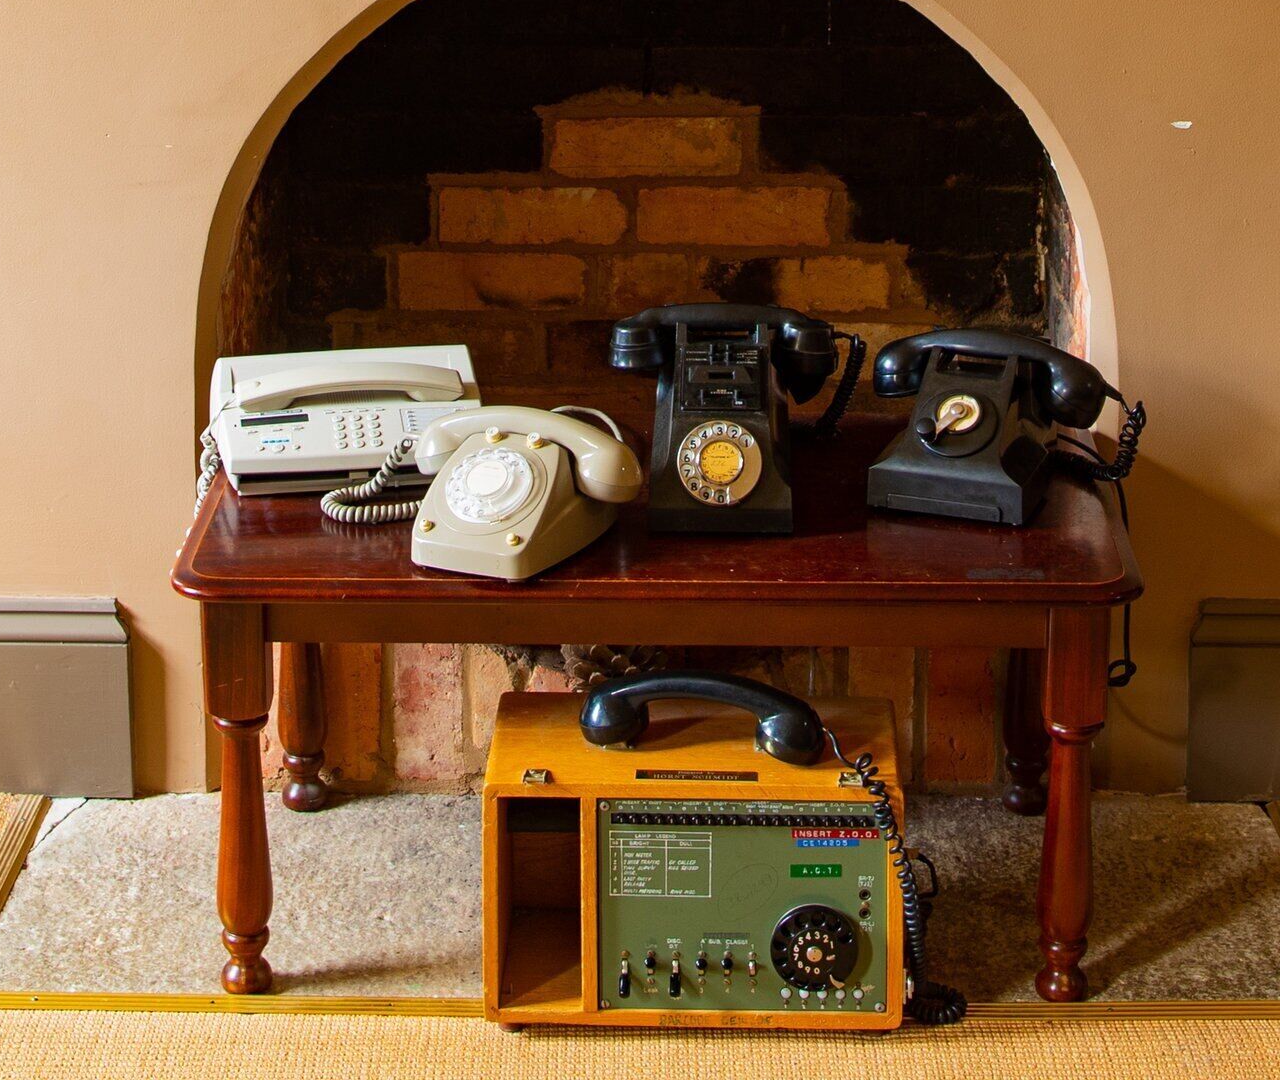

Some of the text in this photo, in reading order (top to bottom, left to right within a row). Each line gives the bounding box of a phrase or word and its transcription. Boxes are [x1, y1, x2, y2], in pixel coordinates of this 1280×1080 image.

[684, 426, 749, 503] 1 2 3 4 5 6 7 8 9 0
[793, 830, 832, 838] INSERT
[805, 932, 811, 940] 4
[814, 931, 820, 940] 3
[823, 934, 829, 943] 2
[798, 937, 804, 945] 5
[830, 941, 834, 949] 1
[793, 944, 799, 952] 6
[793, 953, 799, 961] 7
[797, 961, 804, 969] 8
[804, 966, 811, 974] 9
